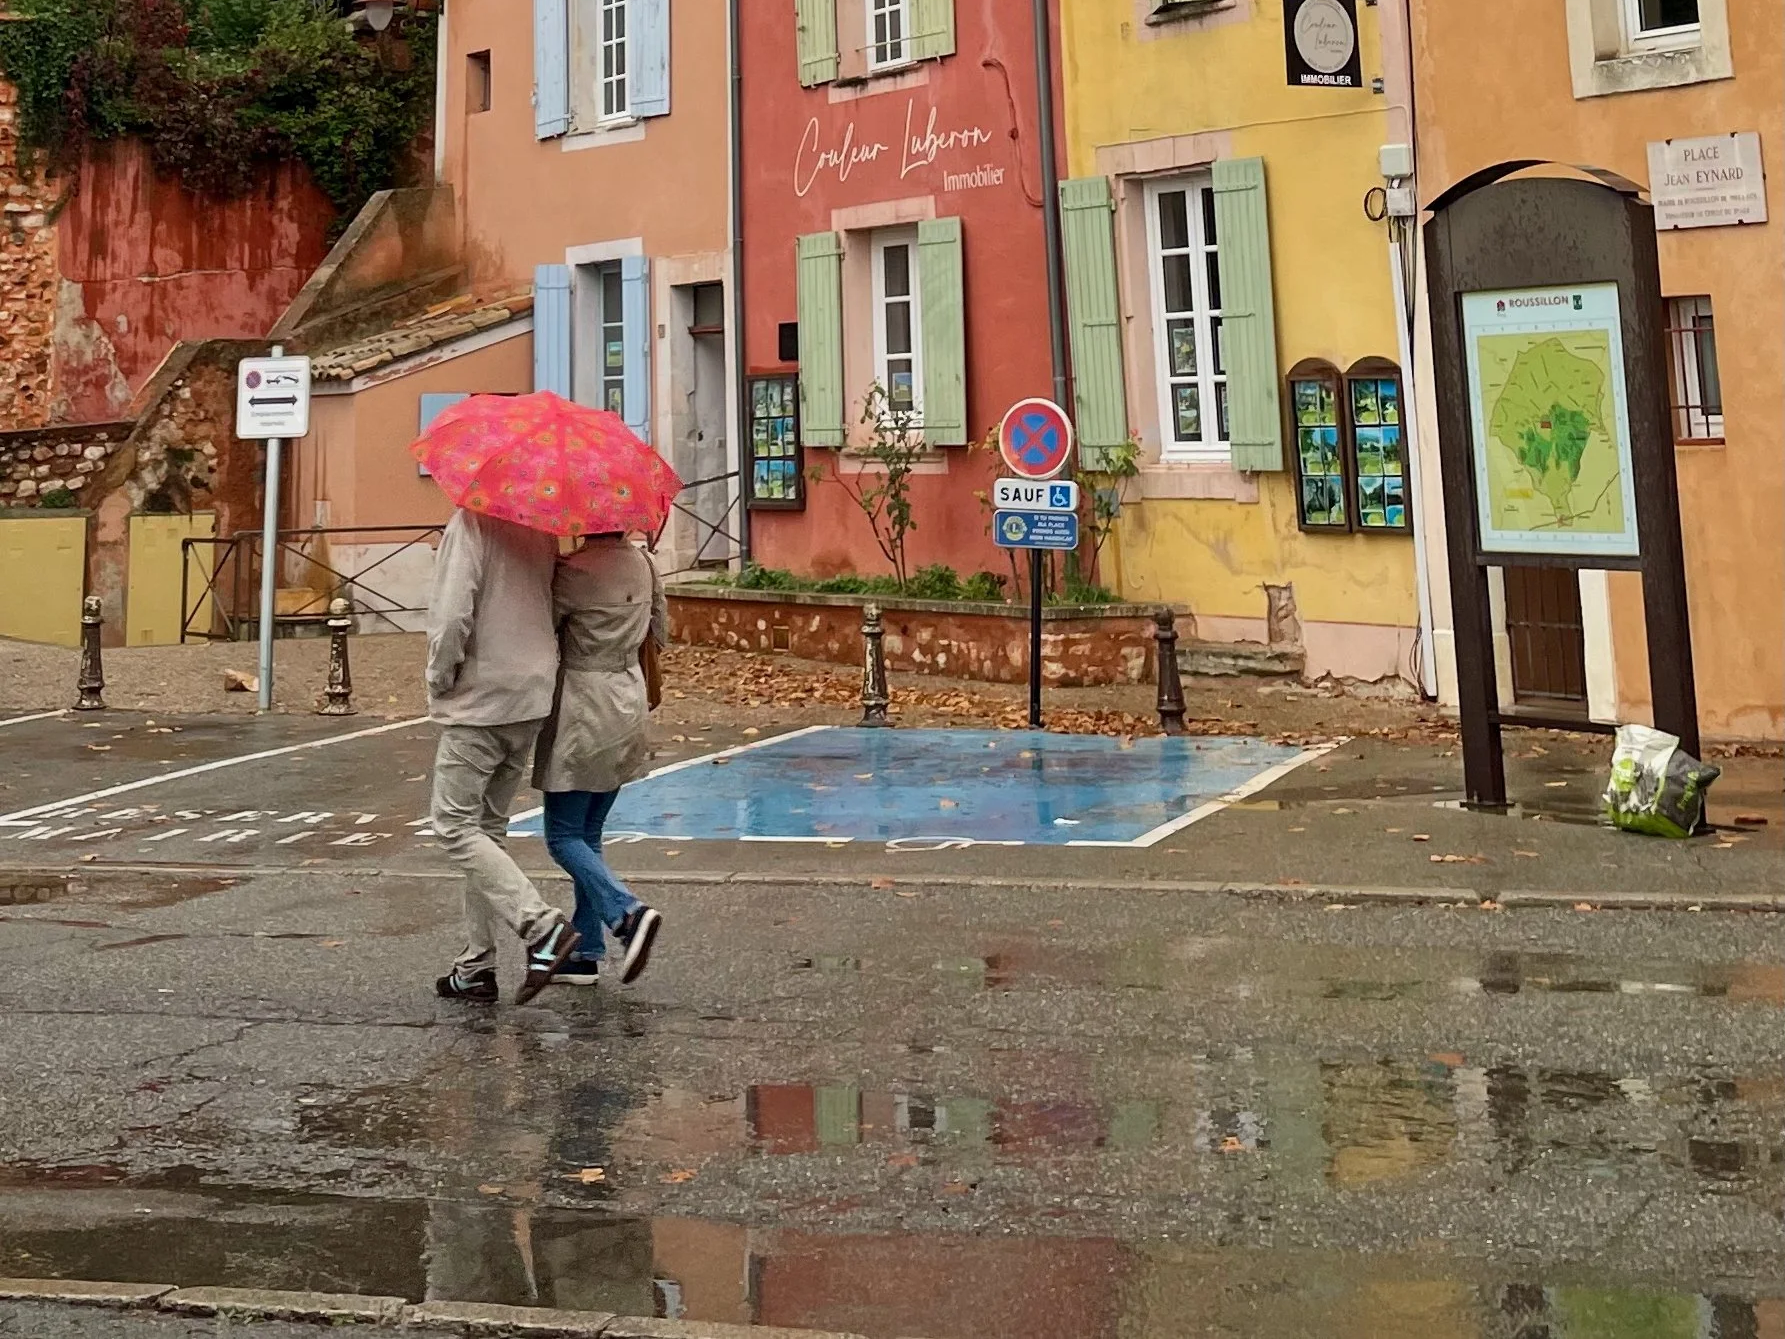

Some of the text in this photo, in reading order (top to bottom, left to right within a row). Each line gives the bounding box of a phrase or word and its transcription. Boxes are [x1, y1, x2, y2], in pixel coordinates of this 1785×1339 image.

[1300, 74, 1352, 86] IMMOBILIER
[793, 98, 992, 198] Couleur Luberon
[1683, 146, 1720, 162] PLACE
[943, 163, 1005, 192] Immobilier
[1663, 167, 1744, 187] JEAN EYNARD
[1508, 295, 1569, 308] ROUSSILLON
[1000, 487, 1045, 503] SAUF
